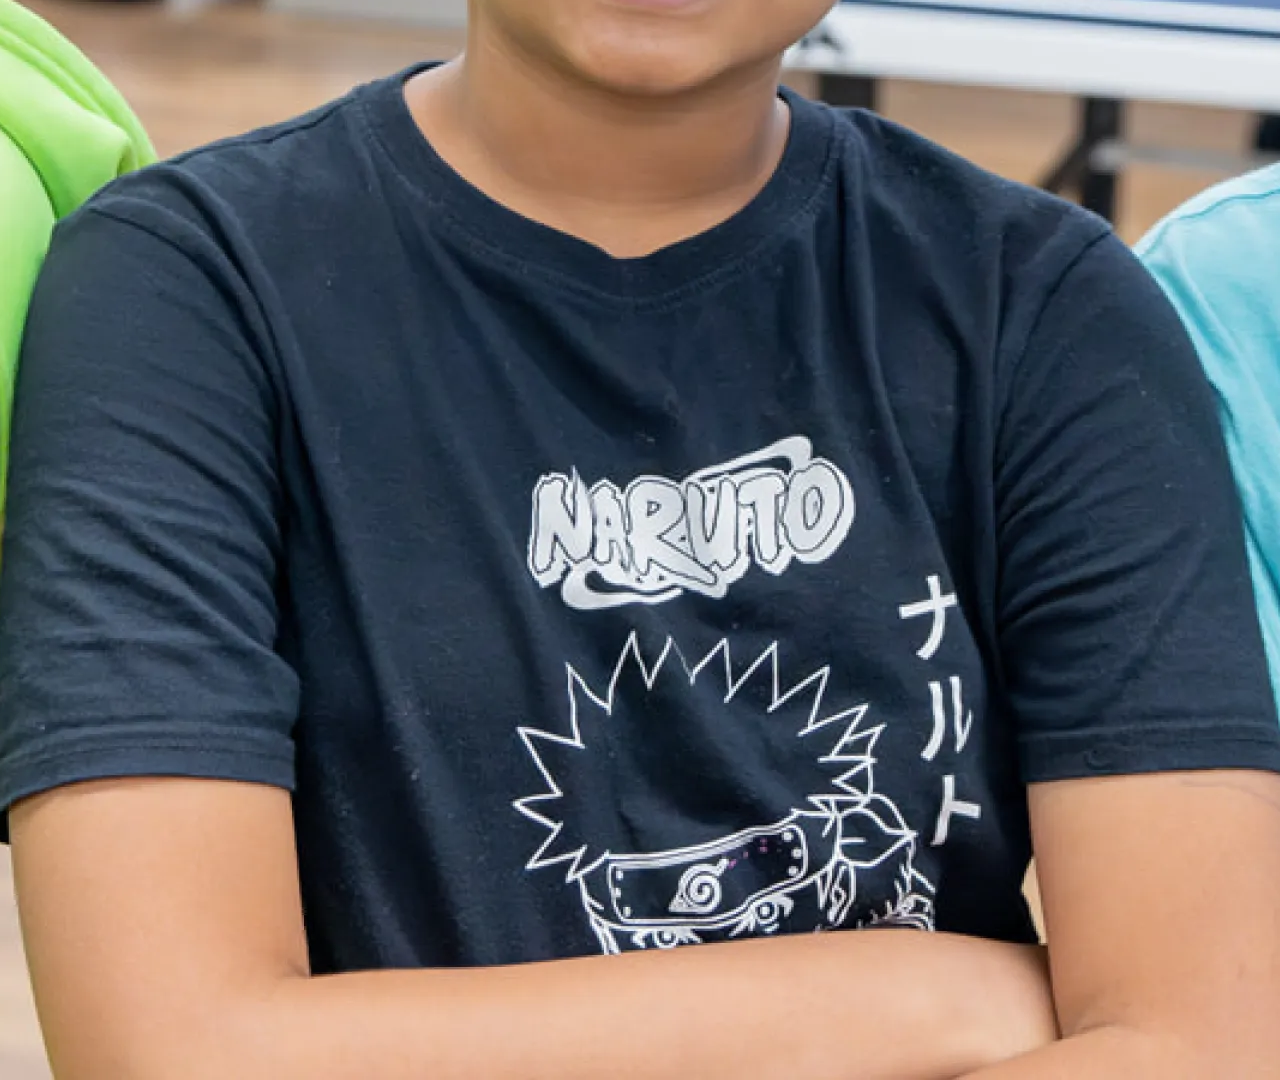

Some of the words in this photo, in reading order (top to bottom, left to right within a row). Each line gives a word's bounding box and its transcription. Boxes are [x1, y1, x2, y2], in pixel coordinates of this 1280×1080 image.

[528, 450, 854, 601] NARUTO
[899, 575, 981, 845] ナルト
